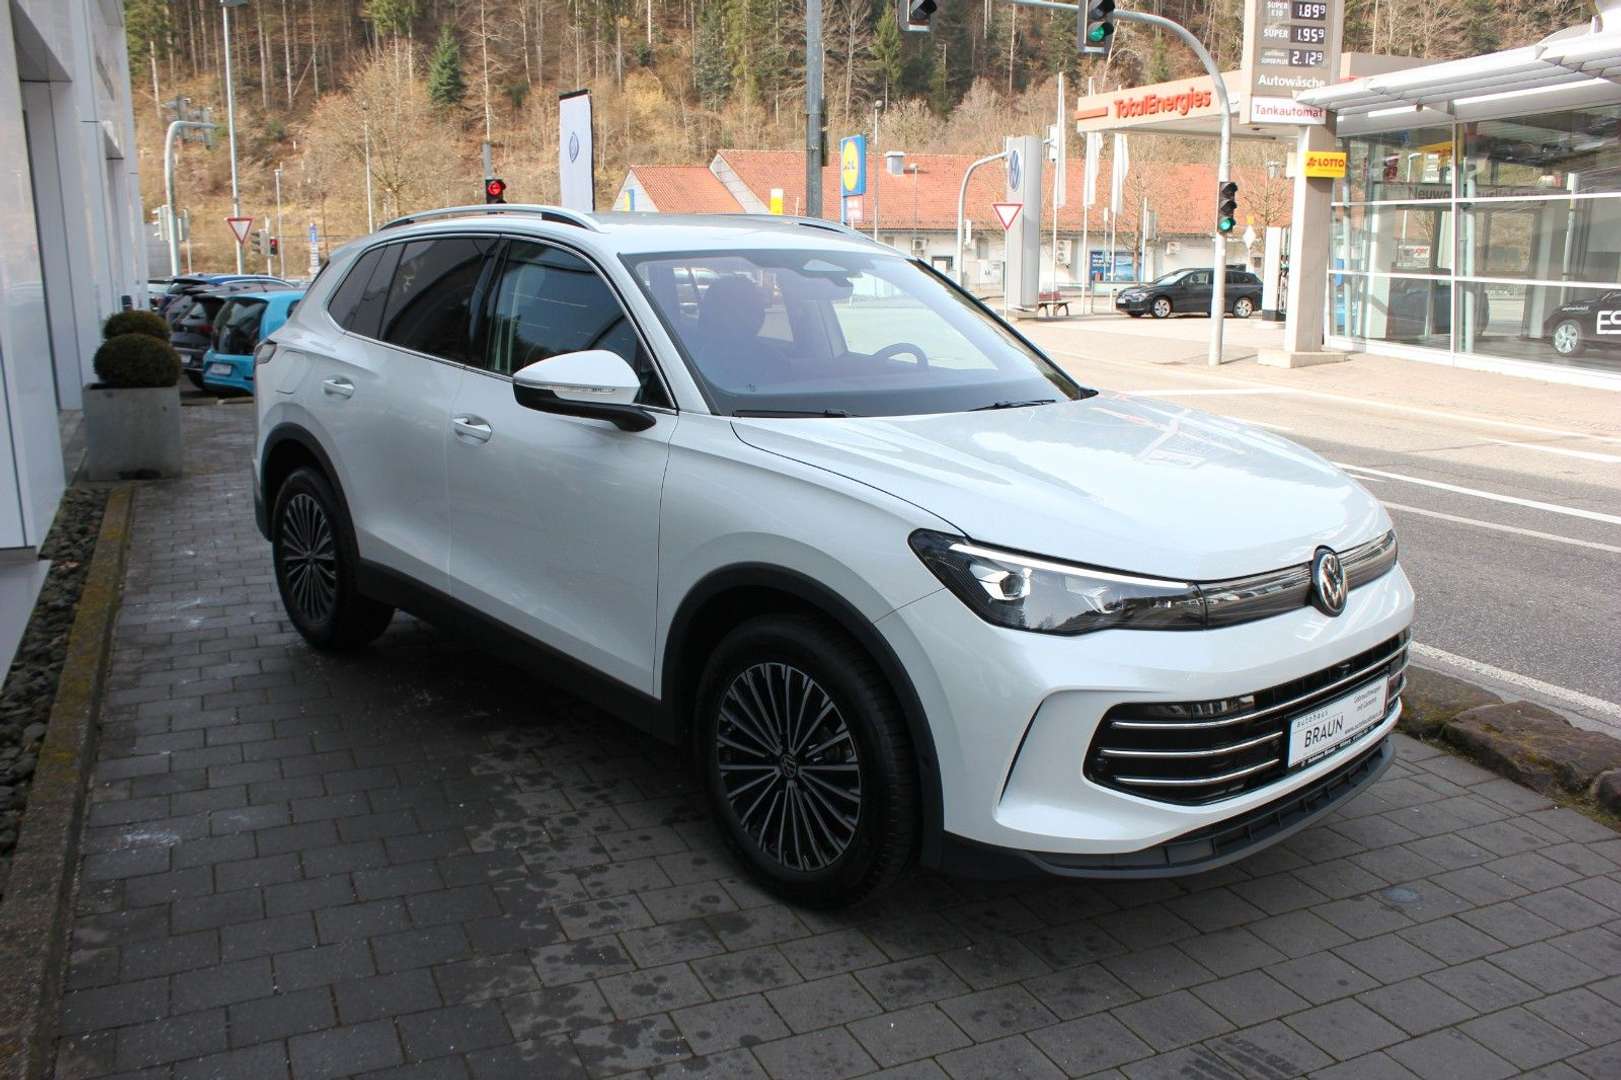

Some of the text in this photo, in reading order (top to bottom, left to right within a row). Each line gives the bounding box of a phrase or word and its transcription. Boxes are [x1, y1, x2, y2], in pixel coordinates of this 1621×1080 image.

[1263, 28, 1288, 38] SUPER
[1114, 88, 1212, 118] TotalEnergies
[1256, 104, 1323, 118] Tankautomat
[1318, 158, 1345, 168] LOTTO
[1304, 714, 1344, 749] BRAUN
